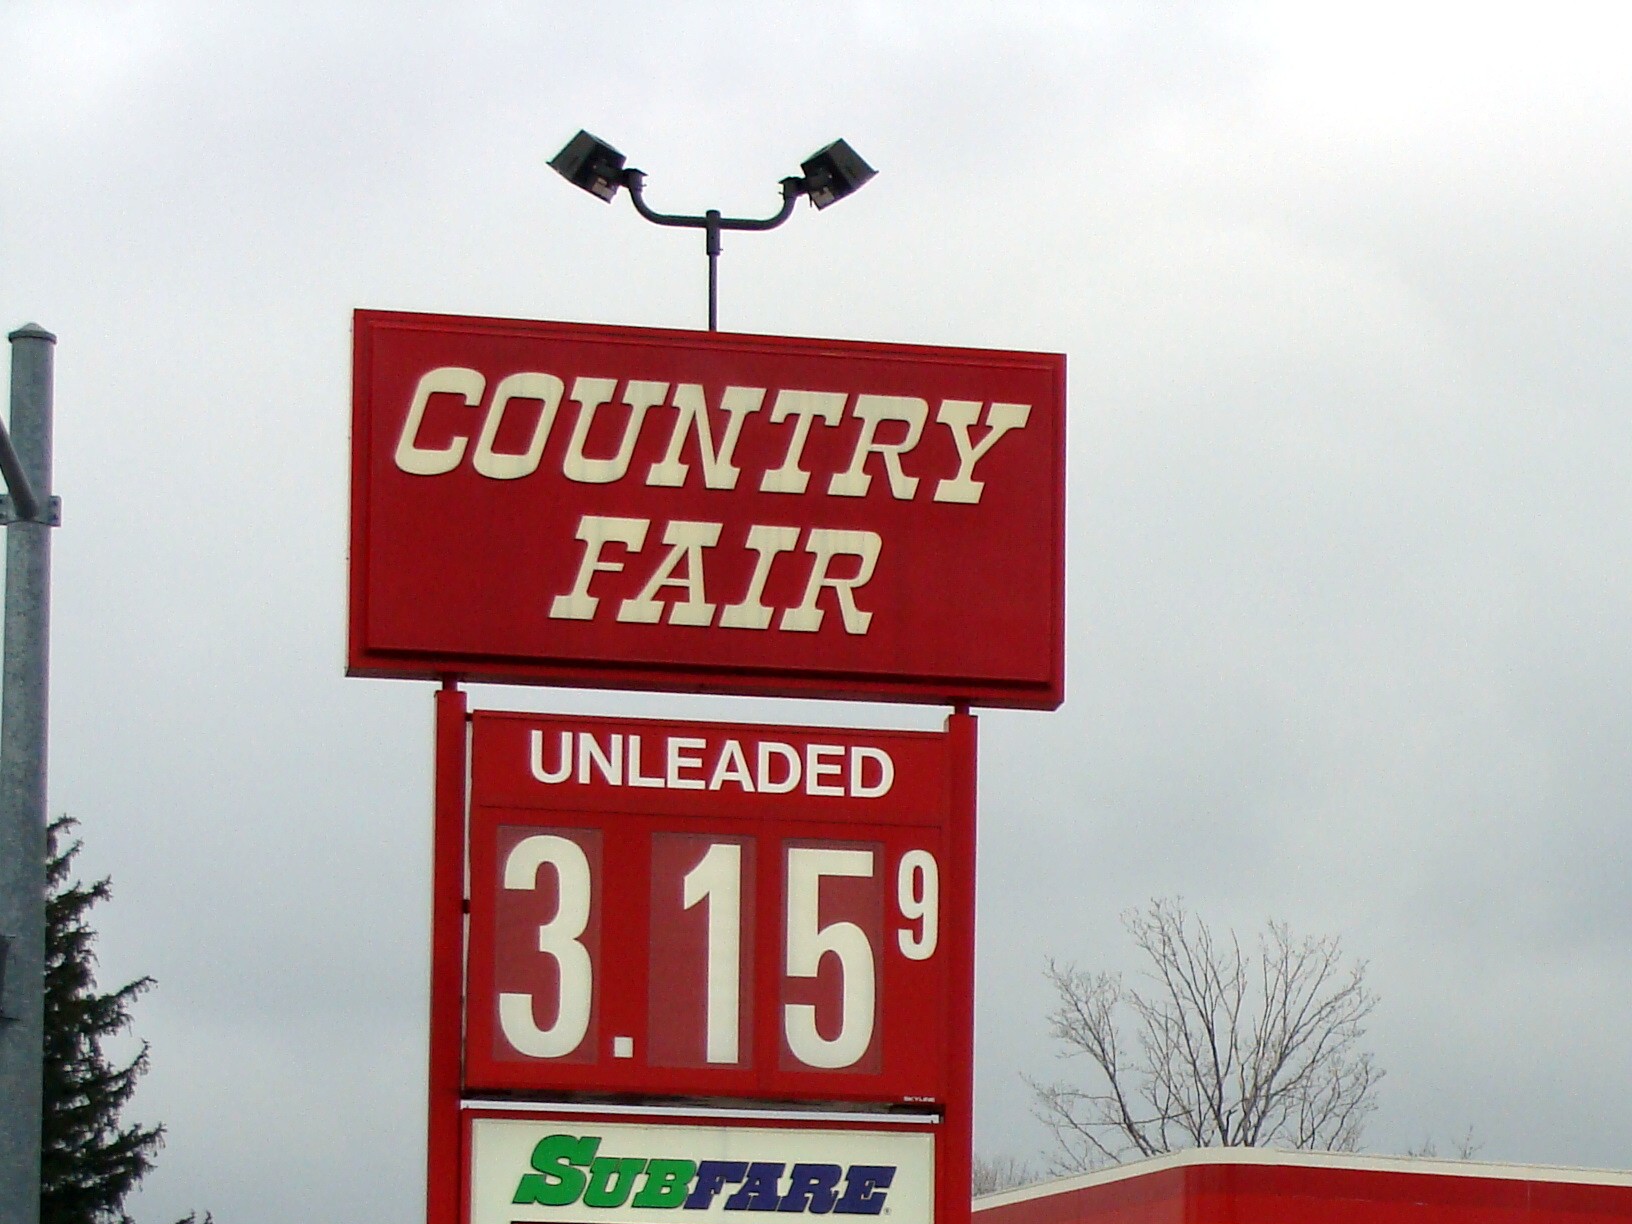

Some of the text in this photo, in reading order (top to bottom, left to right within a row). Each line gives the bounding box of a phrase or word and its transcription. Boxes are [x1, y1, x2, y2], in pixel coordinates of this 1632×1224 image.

[395, 366, 1032, 504] COUNTRY
[548, 514, 882, 635] FAIR
[530, 729, 895, 799] UNLEADED
[897, 849, 939, 961] 9
